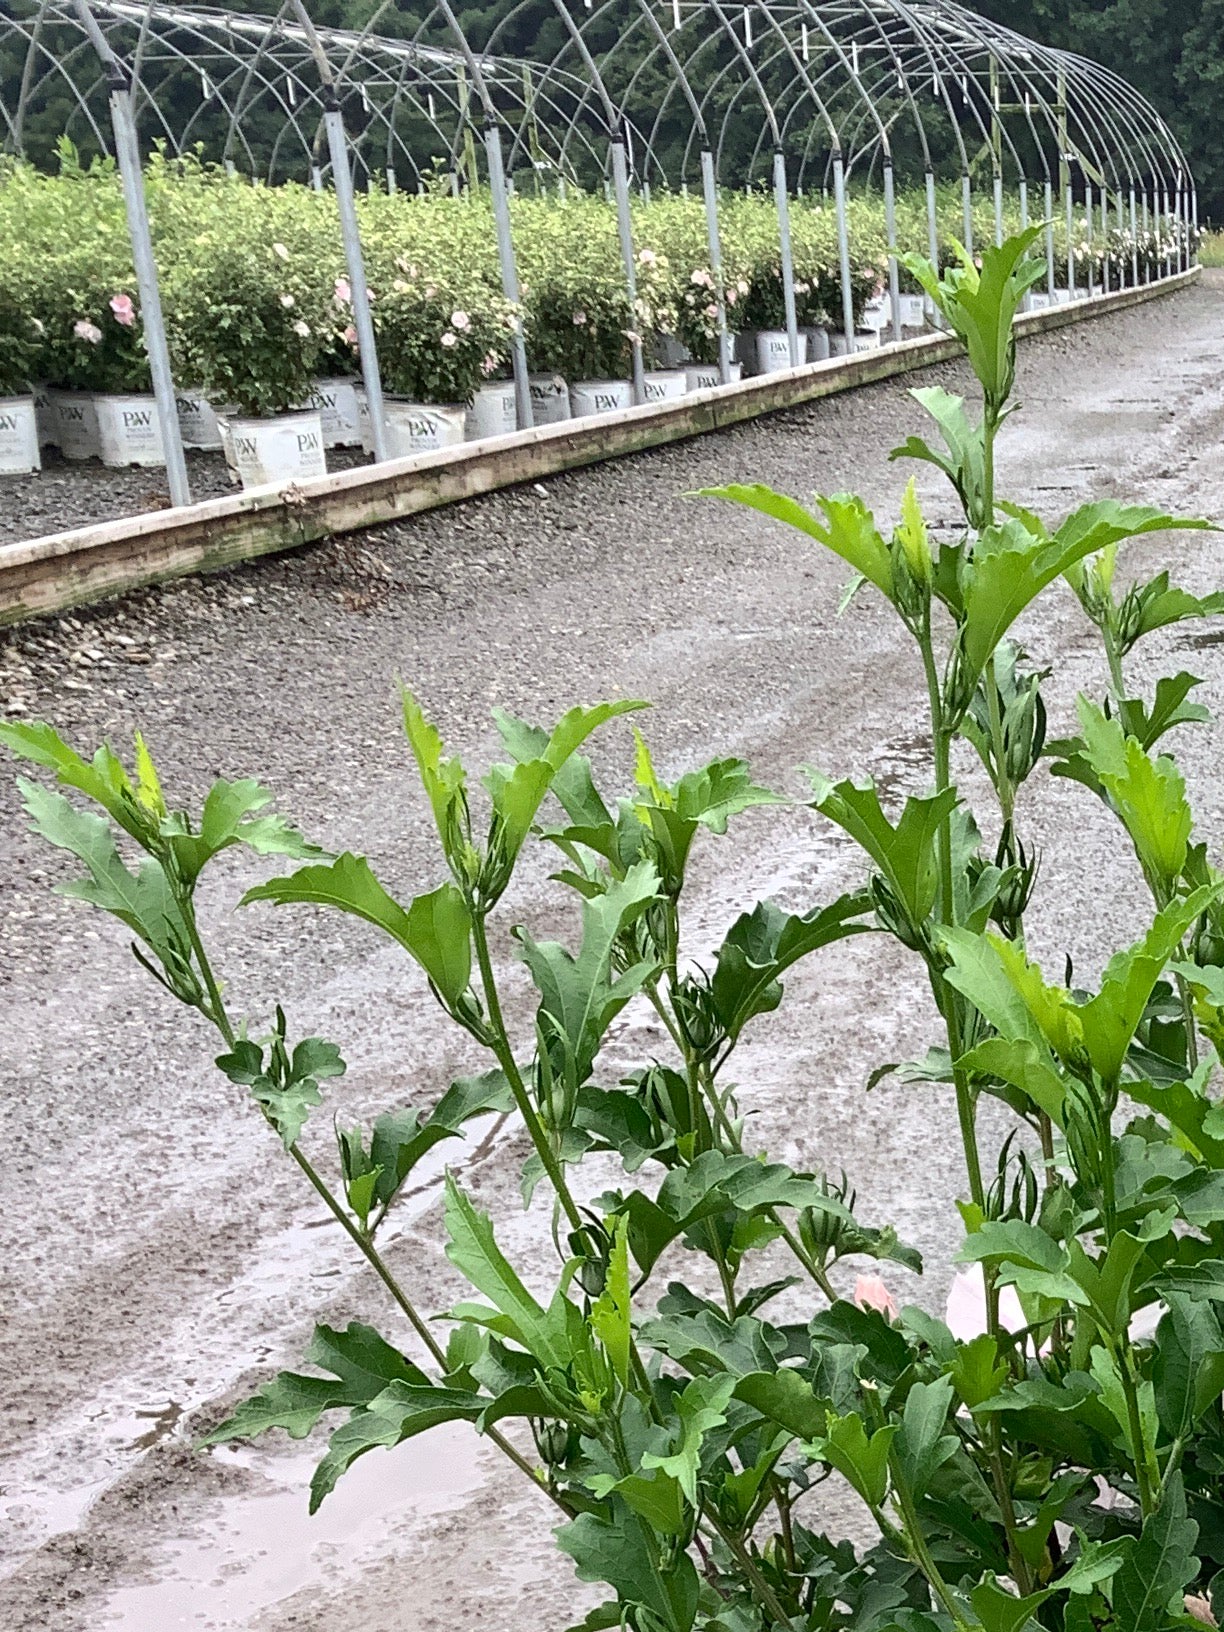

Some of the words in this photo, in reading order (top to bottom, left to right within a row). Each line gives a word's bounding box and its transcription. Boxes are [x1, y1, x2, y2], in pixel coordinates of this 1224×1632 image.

[594, 394, 620, 409] PW
[123, 411, 152, 427] PW
[408, 420, 438, 436] PW
